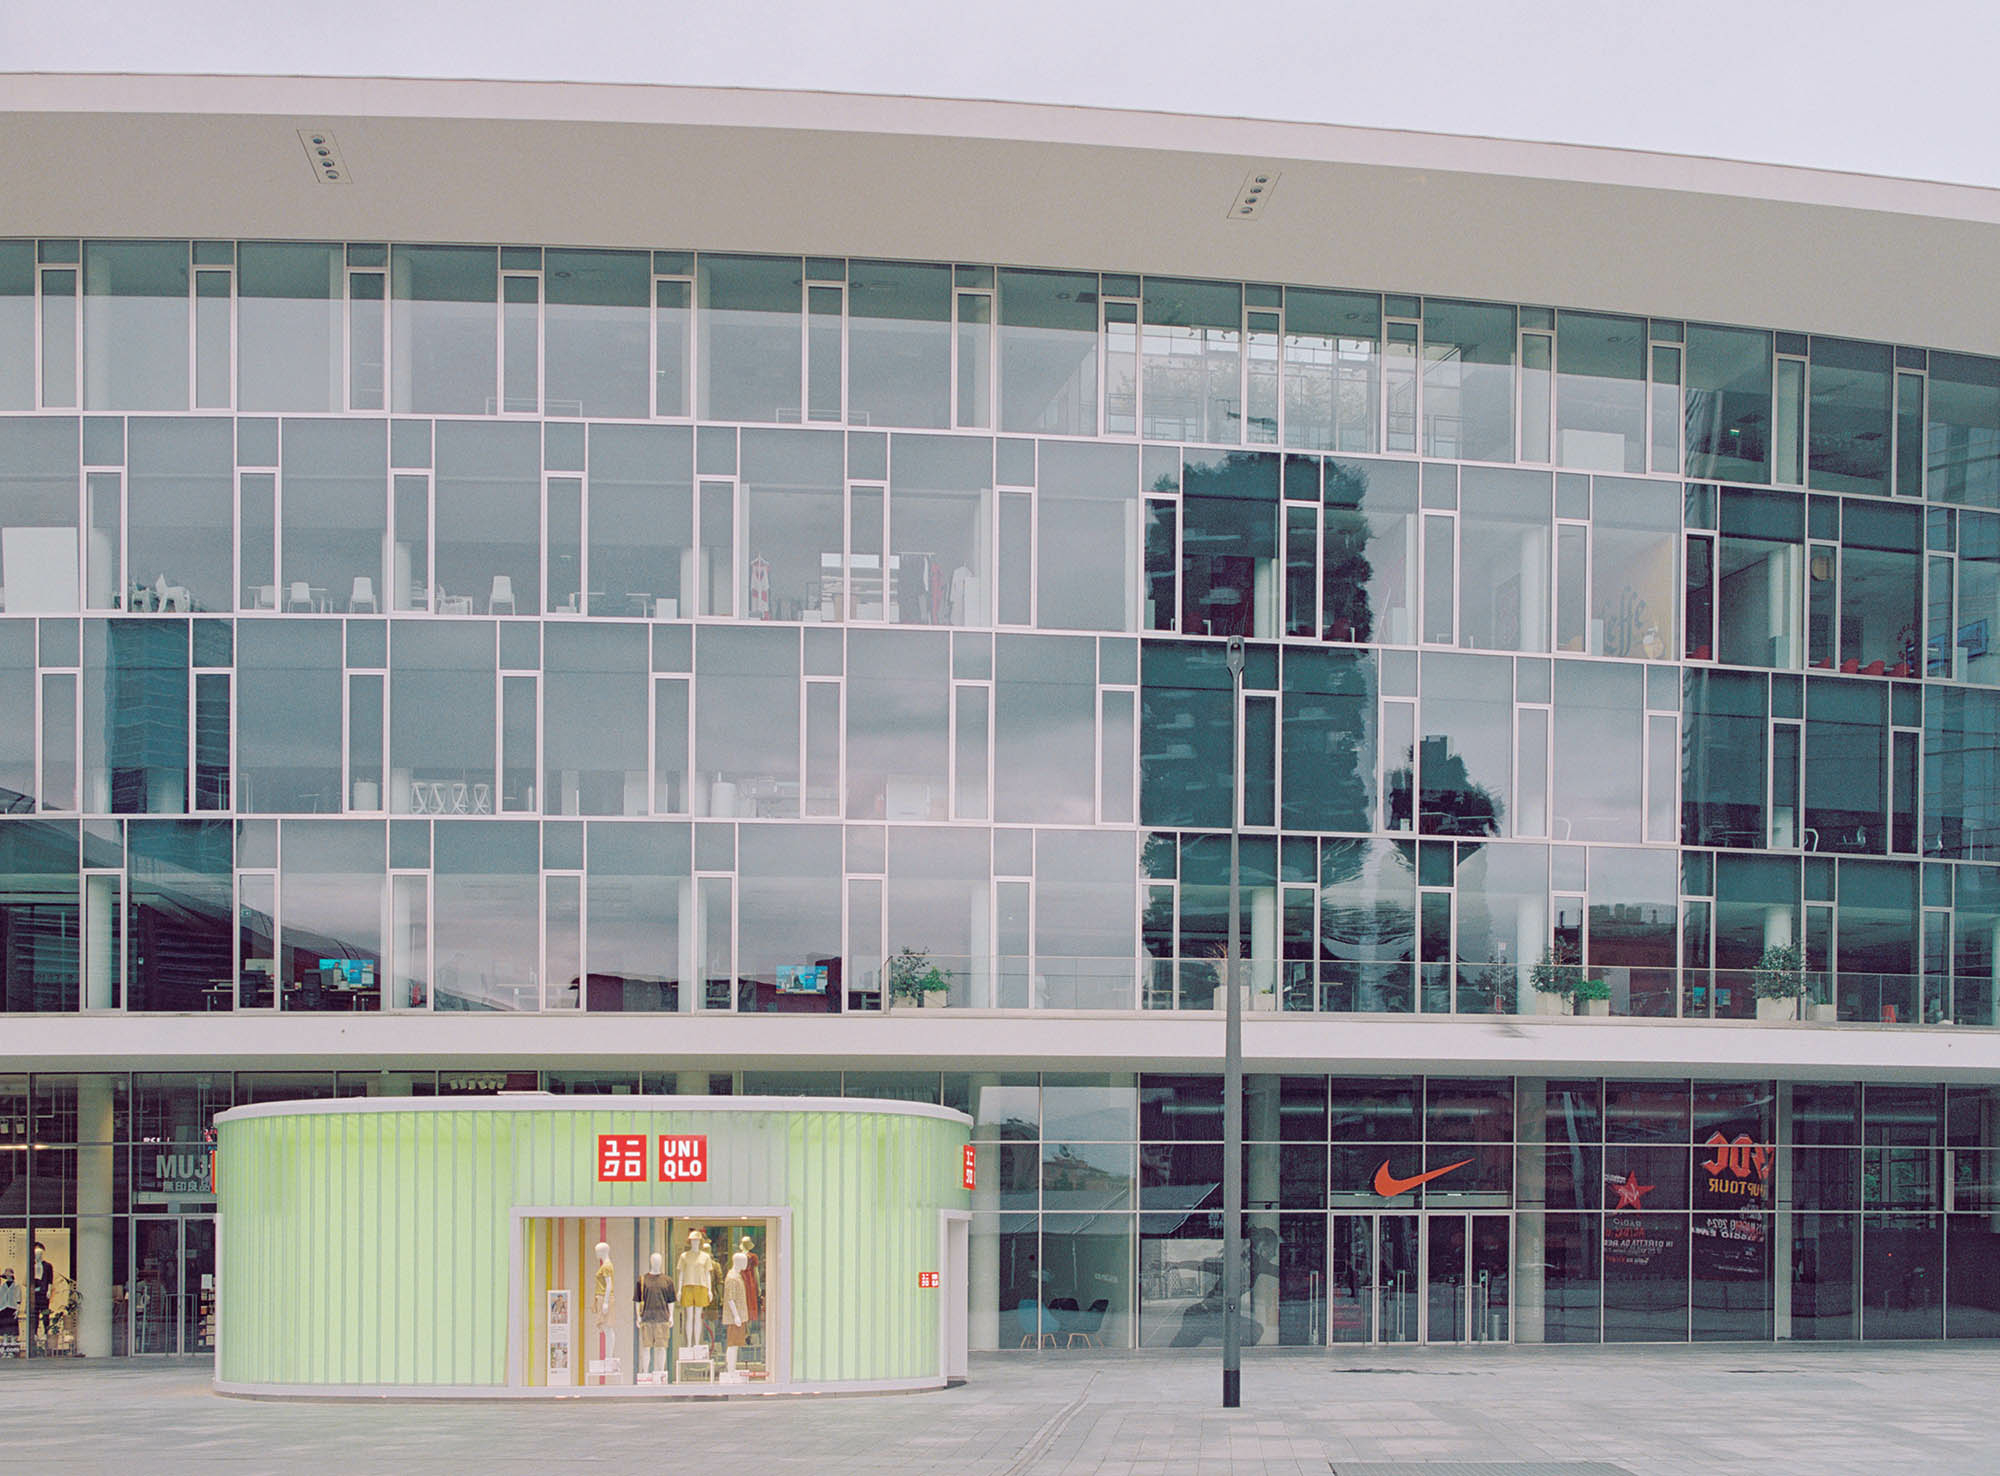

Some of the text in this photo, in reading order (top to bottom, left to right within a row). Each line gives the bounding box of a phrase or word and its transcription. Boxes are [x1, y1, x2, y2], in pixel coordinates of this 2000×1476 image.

[664, 1140, 699, 1157] UNI
[156, 1154, 209, 1179] MUJ
[664, 1160, 702, 1179] QLO
